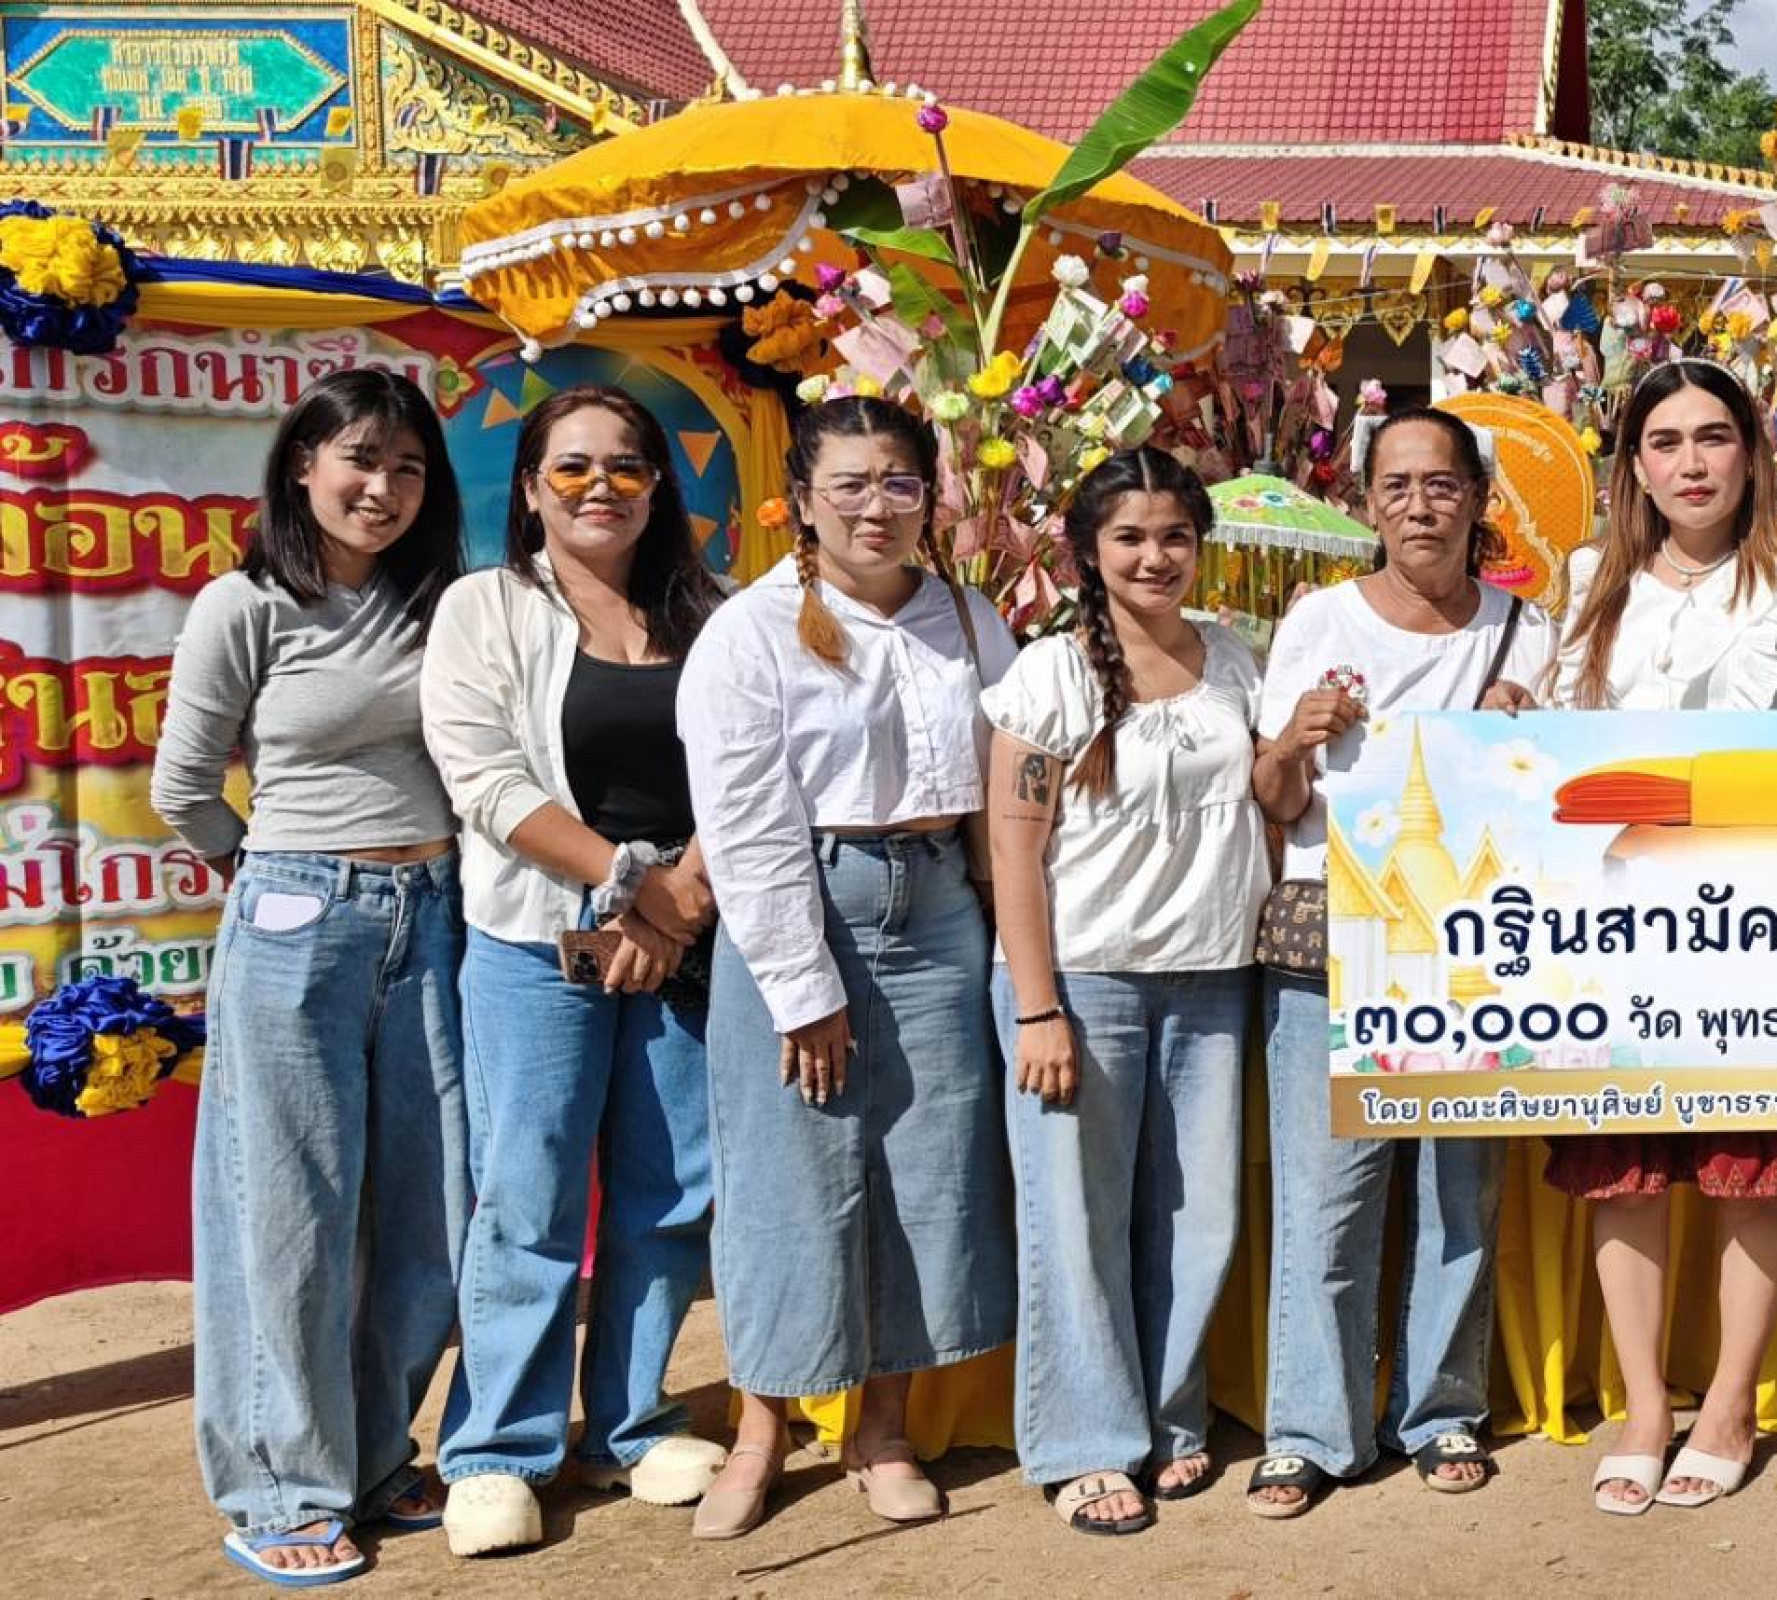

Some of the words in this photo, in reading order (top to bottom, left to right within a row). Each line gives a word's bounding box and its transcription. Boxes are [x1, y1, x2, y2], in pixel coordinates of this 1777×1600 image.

[1354, 1002, 1609, 1053] ๓๐,๐๐๐
[1629, 996, 1682, 1039] วัด
[1363, 1092, 1417, 1120] โดย
[1430, 1086, 1662, 1126] คณะศิษยานุศิษย์
